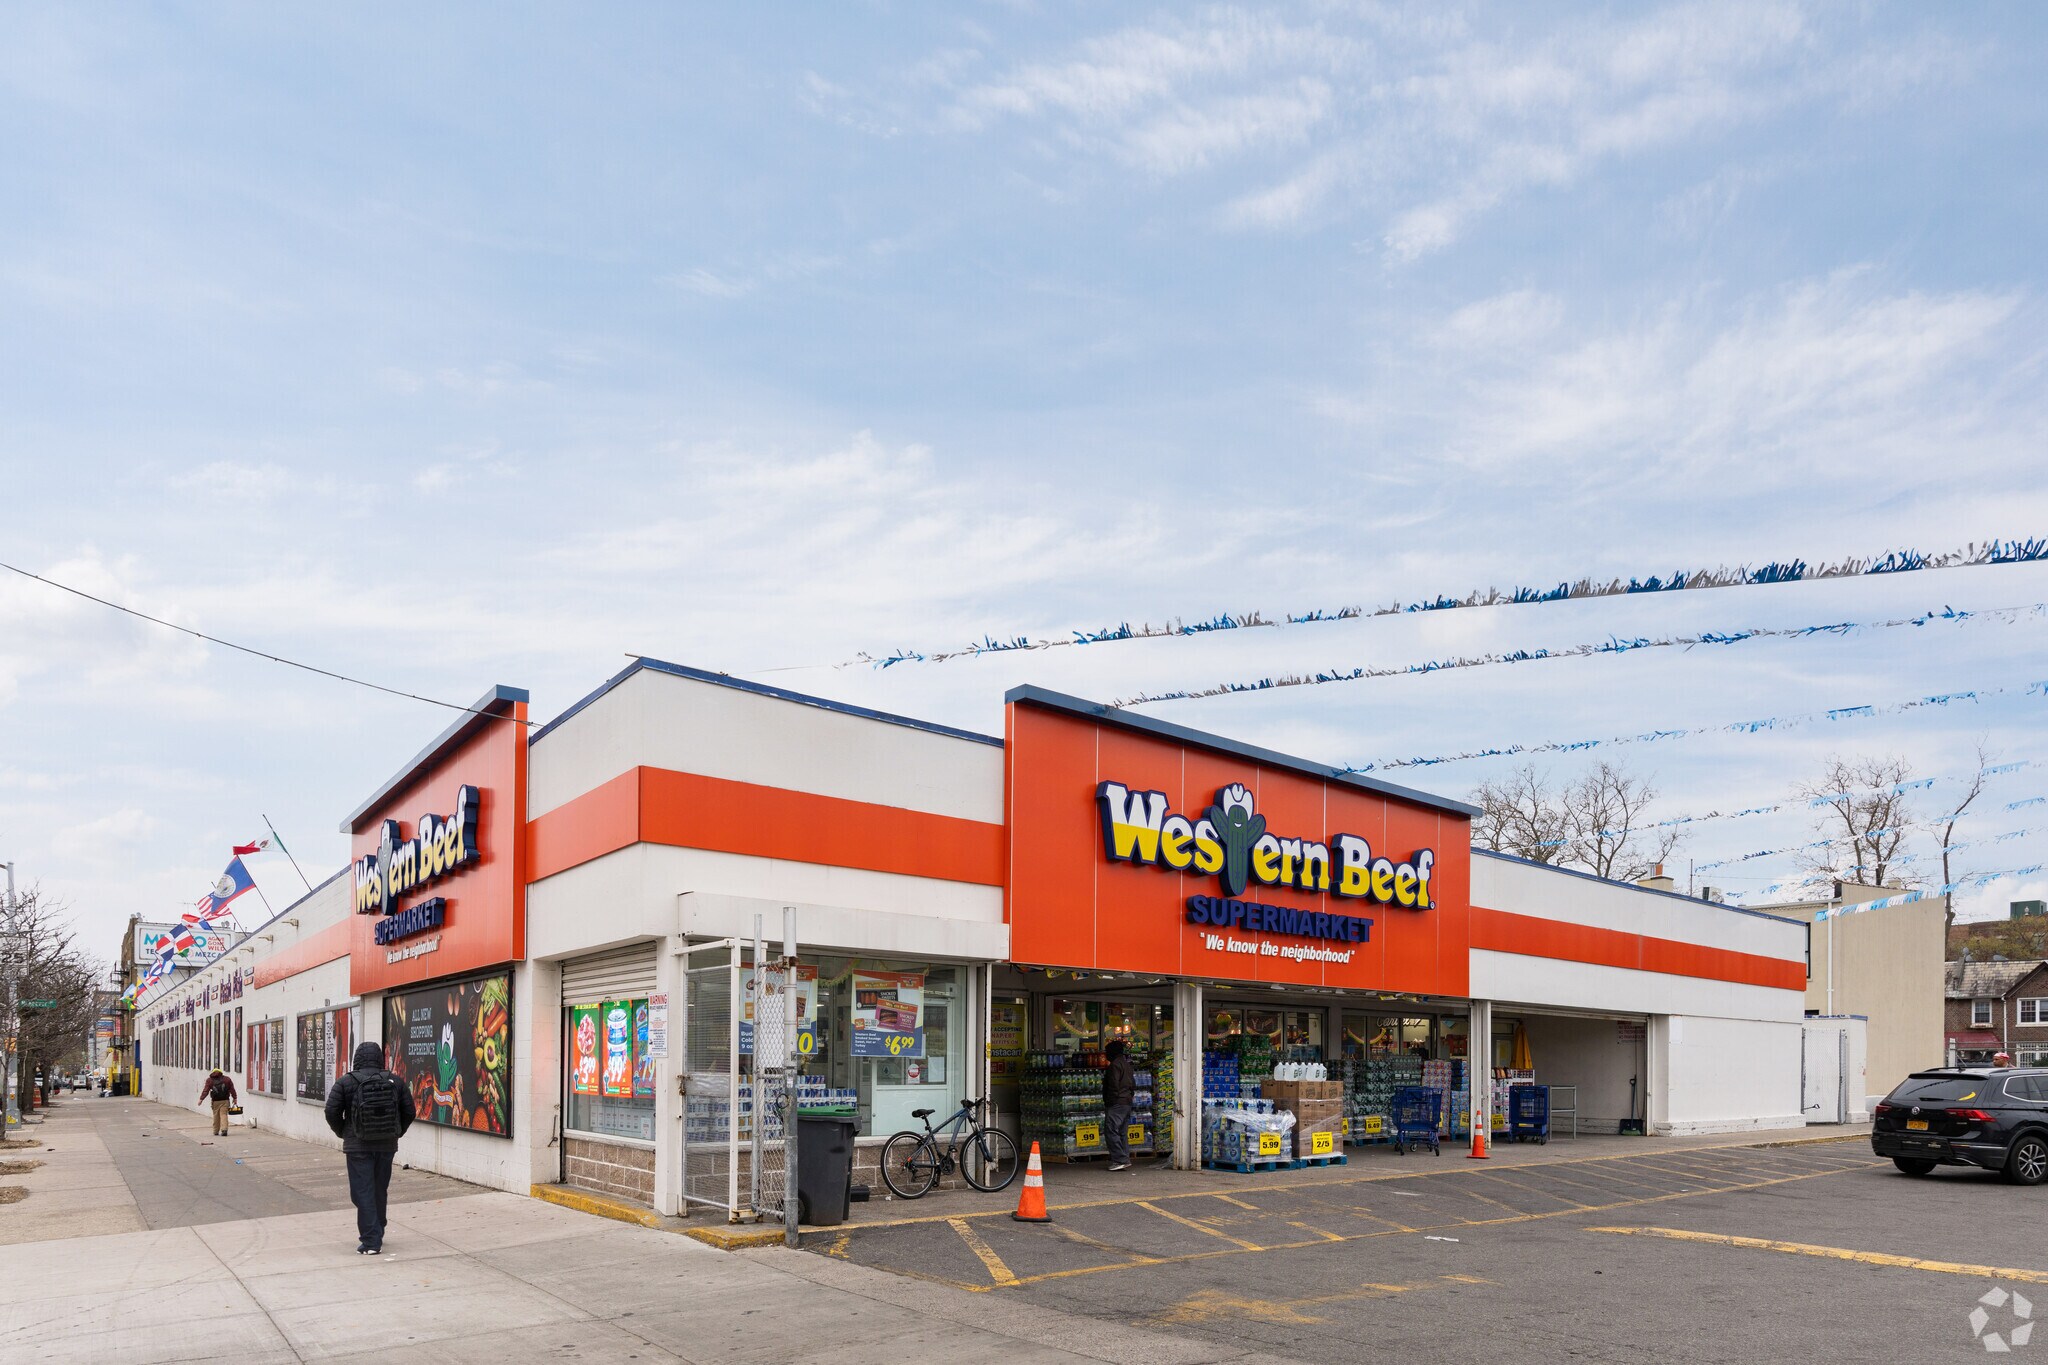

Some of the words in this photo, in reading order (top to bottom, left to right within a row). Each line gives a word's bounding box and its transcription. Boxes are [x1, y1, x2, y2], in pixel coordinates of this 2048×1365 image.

[419, 784, 480, 883] Beef
[1332, 833, 1435, 911] Beef
[374, 897, 445, 945] SUPERMARKET
[1186, 895, 1374, 942] SUPERMARKET
[402, 946, 410, 960] the
[1226, 936, 1258, 954] know
[1260, 941, 1278, 956] the
[649, 994, 668, 1005] WARNING
[412, 1009, 420, 1021] ALL
[420, 1007, 432, 1021] NEW
[410, 1024, 433, 1039] SHOPPING
[408, 1042, 436, 1056] EXPERIENCE
[1262, 1141, 1279, 1149] 5.99
[1316, 1140, 1330, 1148] 2/5
